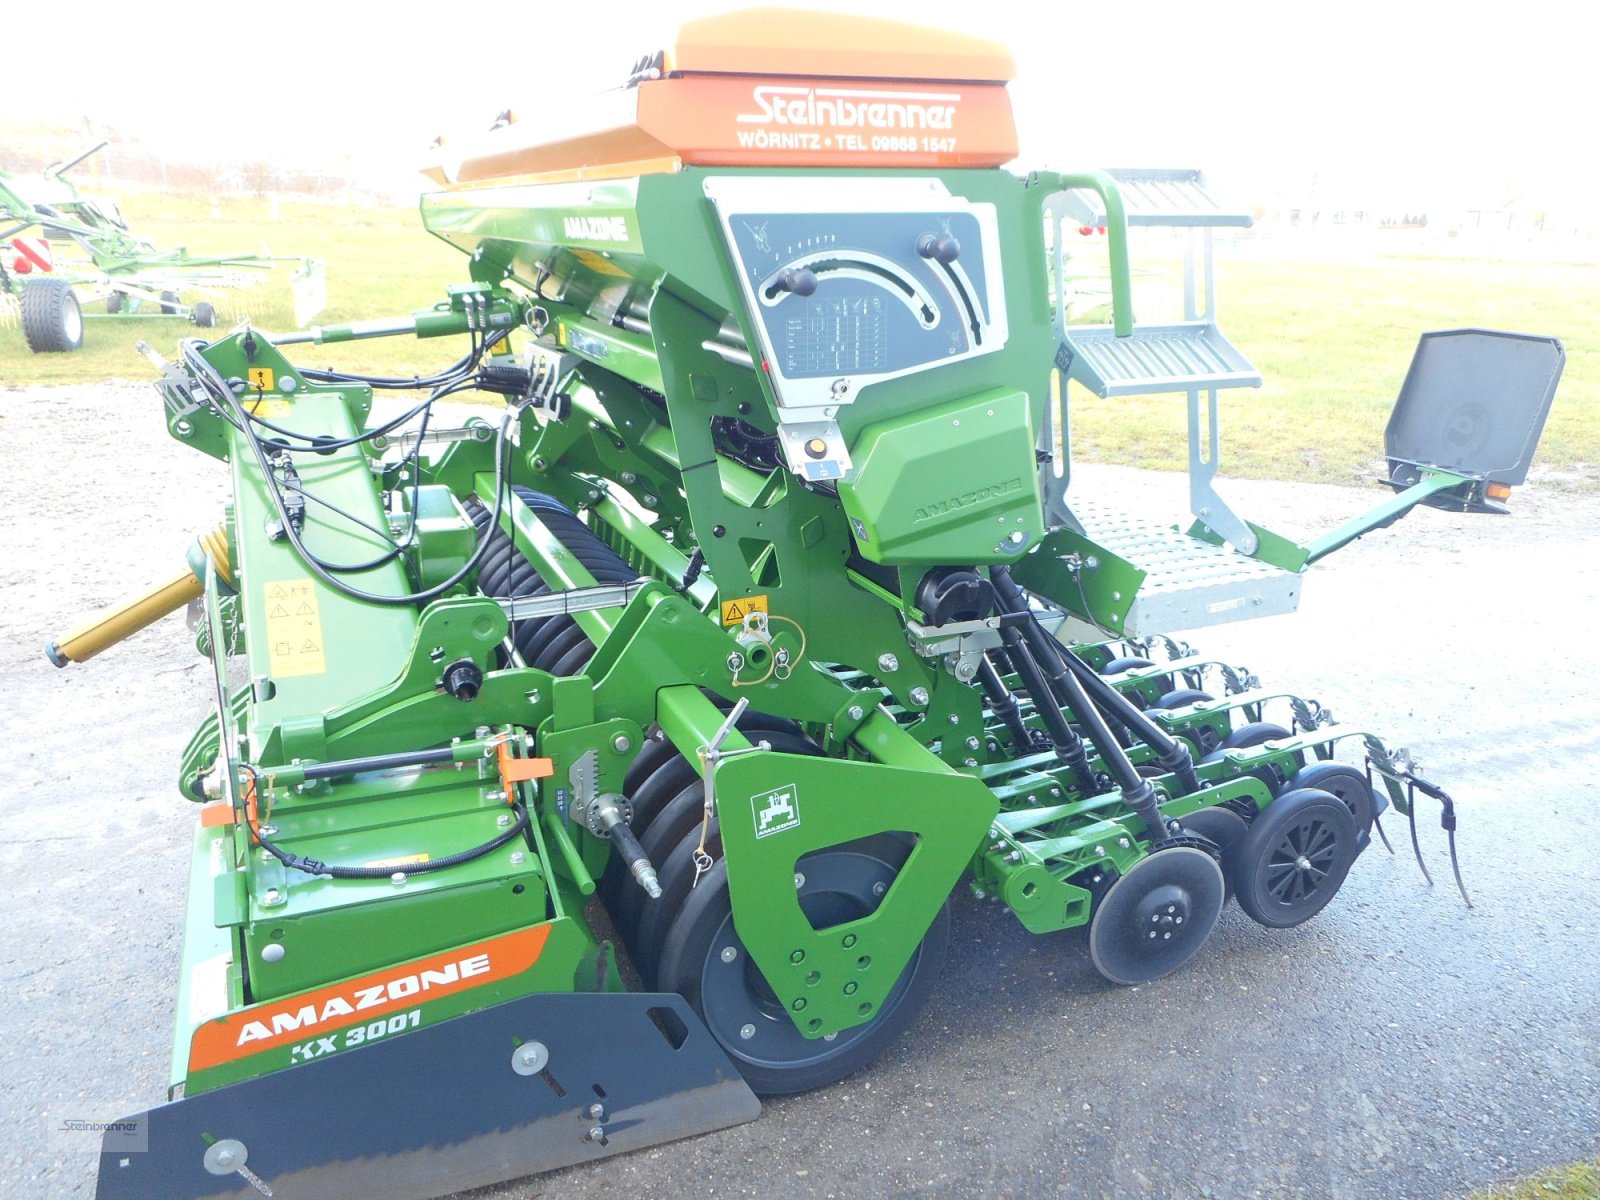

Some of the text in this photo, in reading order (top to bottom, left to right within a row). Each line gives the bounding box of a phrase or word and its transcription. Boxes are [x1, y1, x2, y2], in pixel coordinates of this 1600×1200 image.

[736, 86, 961, 130] Steinbrenner
[737, 129, 821, 149] WÖRNITZ
[835, 135, 867, 151] TEL
[921, 137, 957, 153] 1547
[563, 216, 629, 242] AMAZONE
[236, 953, 491, 1047] AMAZONE
[291, 1009, 421, 1064] KX 3001
